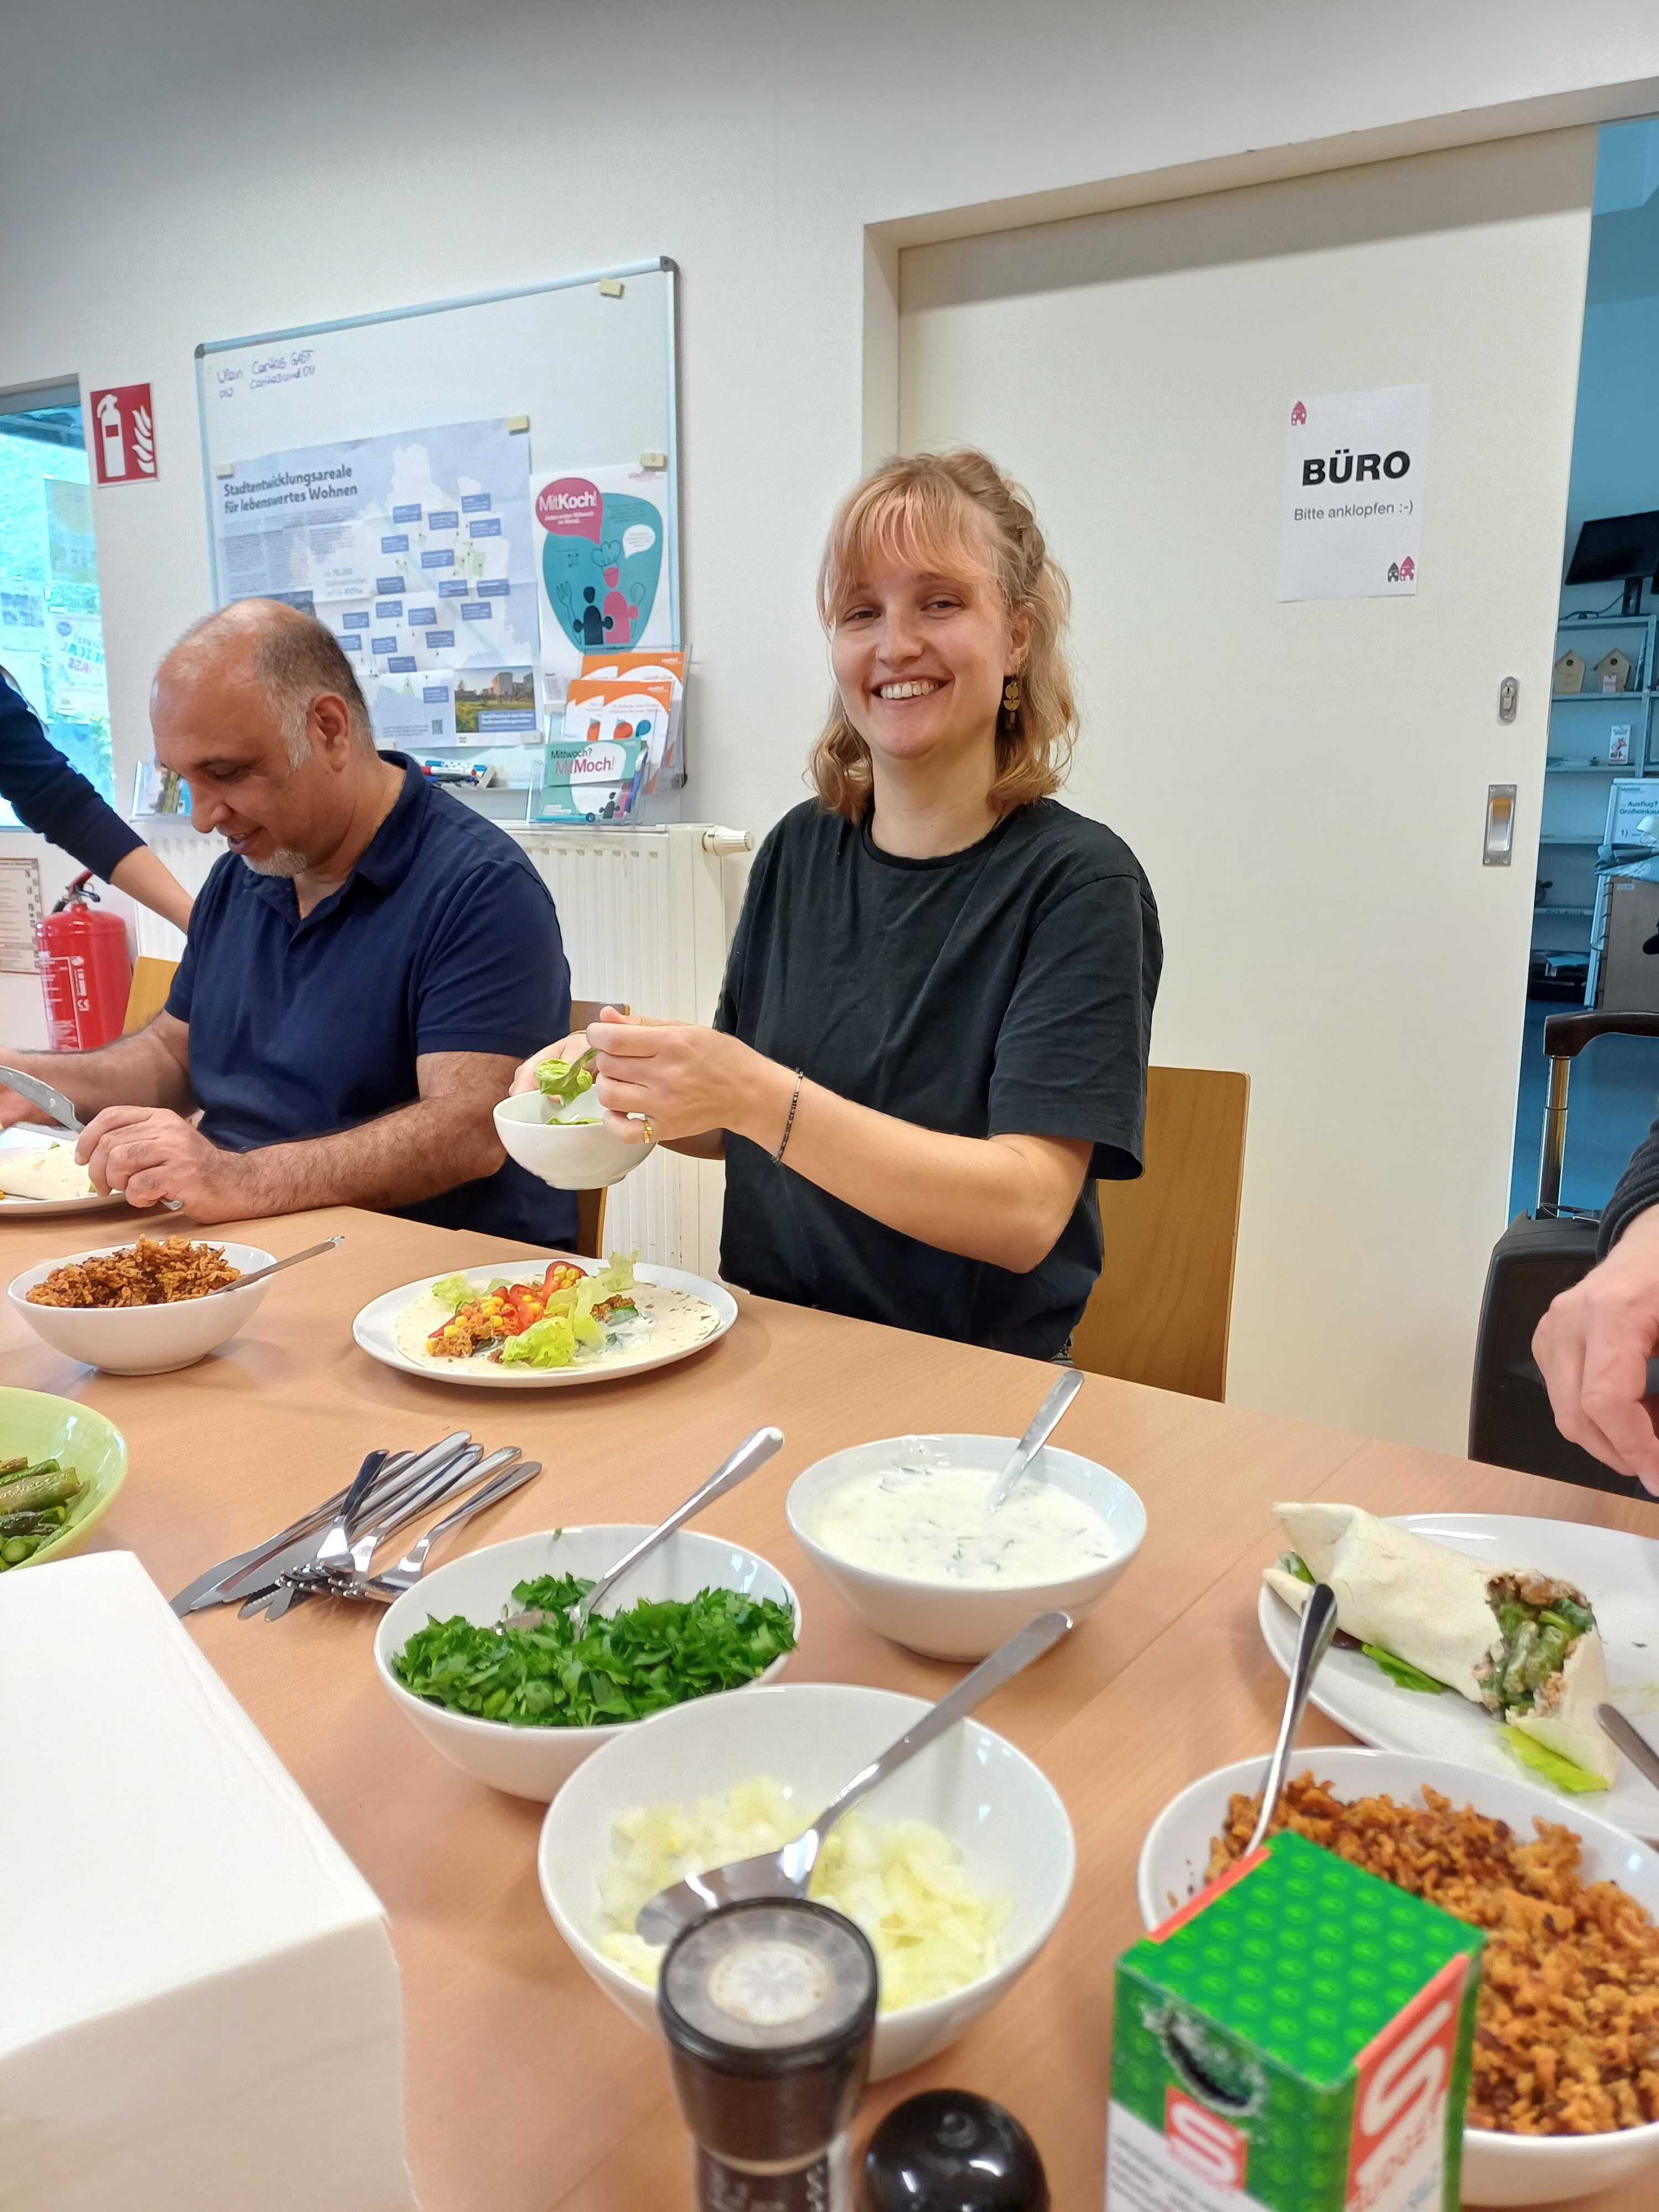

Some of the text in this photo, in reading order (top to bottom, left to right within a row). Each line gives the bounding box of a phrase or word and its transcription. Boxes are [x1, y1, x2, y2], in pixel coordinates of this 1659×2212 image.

[1302, 448, 1410, 487] BÜRO
[224, 463, 353, 497] Stadtentwicklungsareale
[225, 484, 358, 514] für lebenswertes Wohnen
[538, 490, 597, 512] MitKoch!
[1294, 508, 1324, 521] Bitte
[1328, 502, 1394, 519] anklopfen
[550, 747, 593, 760] Mittwoch?
[555, 756, 615, 775] MitMoch!
